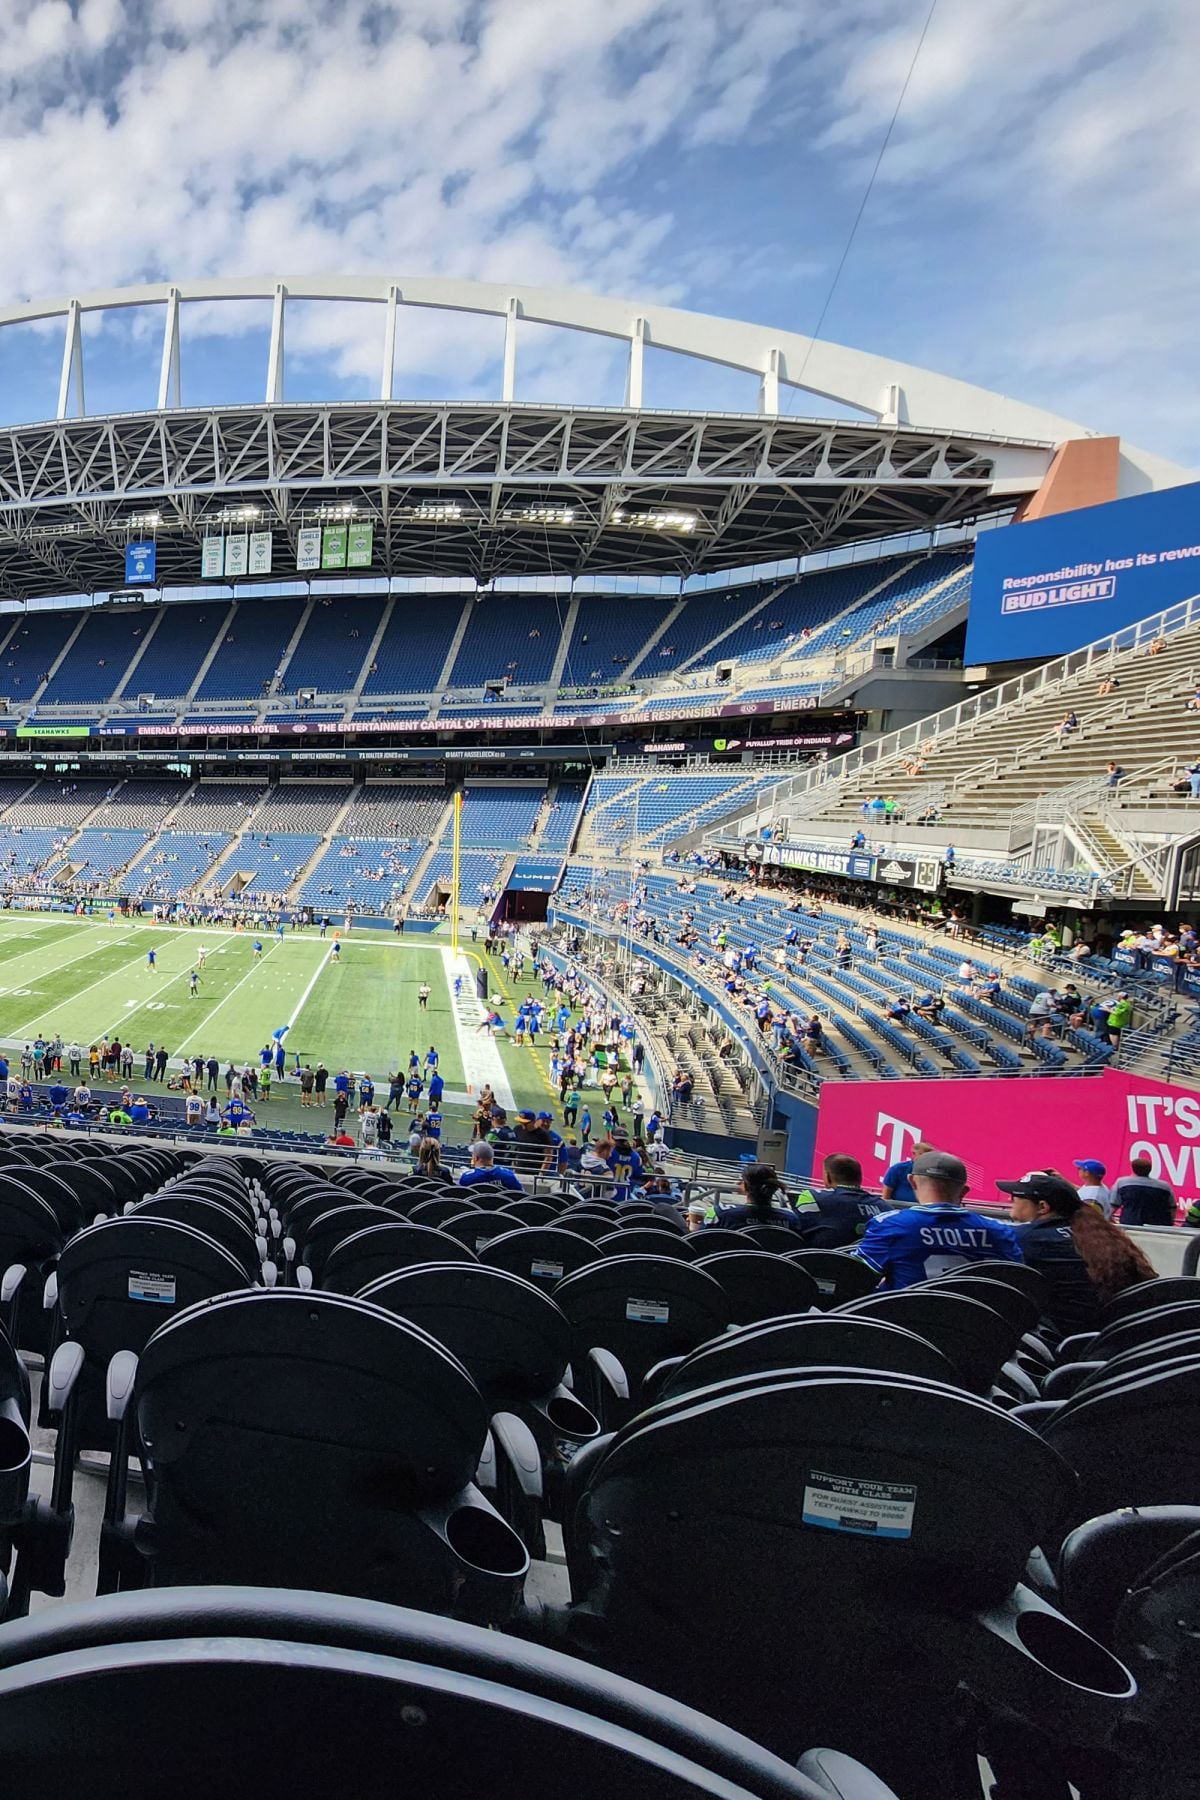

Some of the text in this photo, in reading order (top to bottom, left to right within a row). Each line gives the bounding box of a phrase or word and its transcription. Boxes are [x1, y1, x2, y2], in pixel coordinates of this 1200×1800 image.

[1002, 563, 1103, 590] Responsibility
[1105, 558, 1134, 572] has
[1136, 553, 1157, 567] its
[1005, 580, 1112, 611] BUD LIGHT
[620, 706, 724, 724] GAME RESPONSIBLY
[138, 725, 279, 735] EMERALD QUEEN CASINO & HOTEL
[318, 716, 577, 732] THE ENTERTAINMENT CAPITAL OF THE NORTHWEST
[644, 743, 686, 753] SEAHAWKS
[745, 739, 775, 748] PUYALLUP
[776, 738, 793, 746] TRIBE
[803, 737, 832, 745] INDIANS
[781, 849, 817, 867] HAWKS
[818, 854, 850, 873] NEST
[918, 863, 934, 885] 25
[1115, 951, 1136, 964] LUMEN
[1152, 961, 1173, 975] LUMEN
[232, 1107, 243, 1115] 99
[1126, 1095, 1200, 1139] IT'S
[655, 1151, 667, 1162] 12
[614, 1164, 633, 1183] 10
[857, 1204, 881, 1216] FAN
[920, 1228, 993, 1248] STOLTZ
[810, 1473, 913, 1495] SUPPORT YOUR TEAM
[832, 1485, 892, 1499] WITH CLASS
[811, 1492, 908, 1513] FOR GUEST ASSISTANCE
[813, 1501, 833, 1510] TEXT
